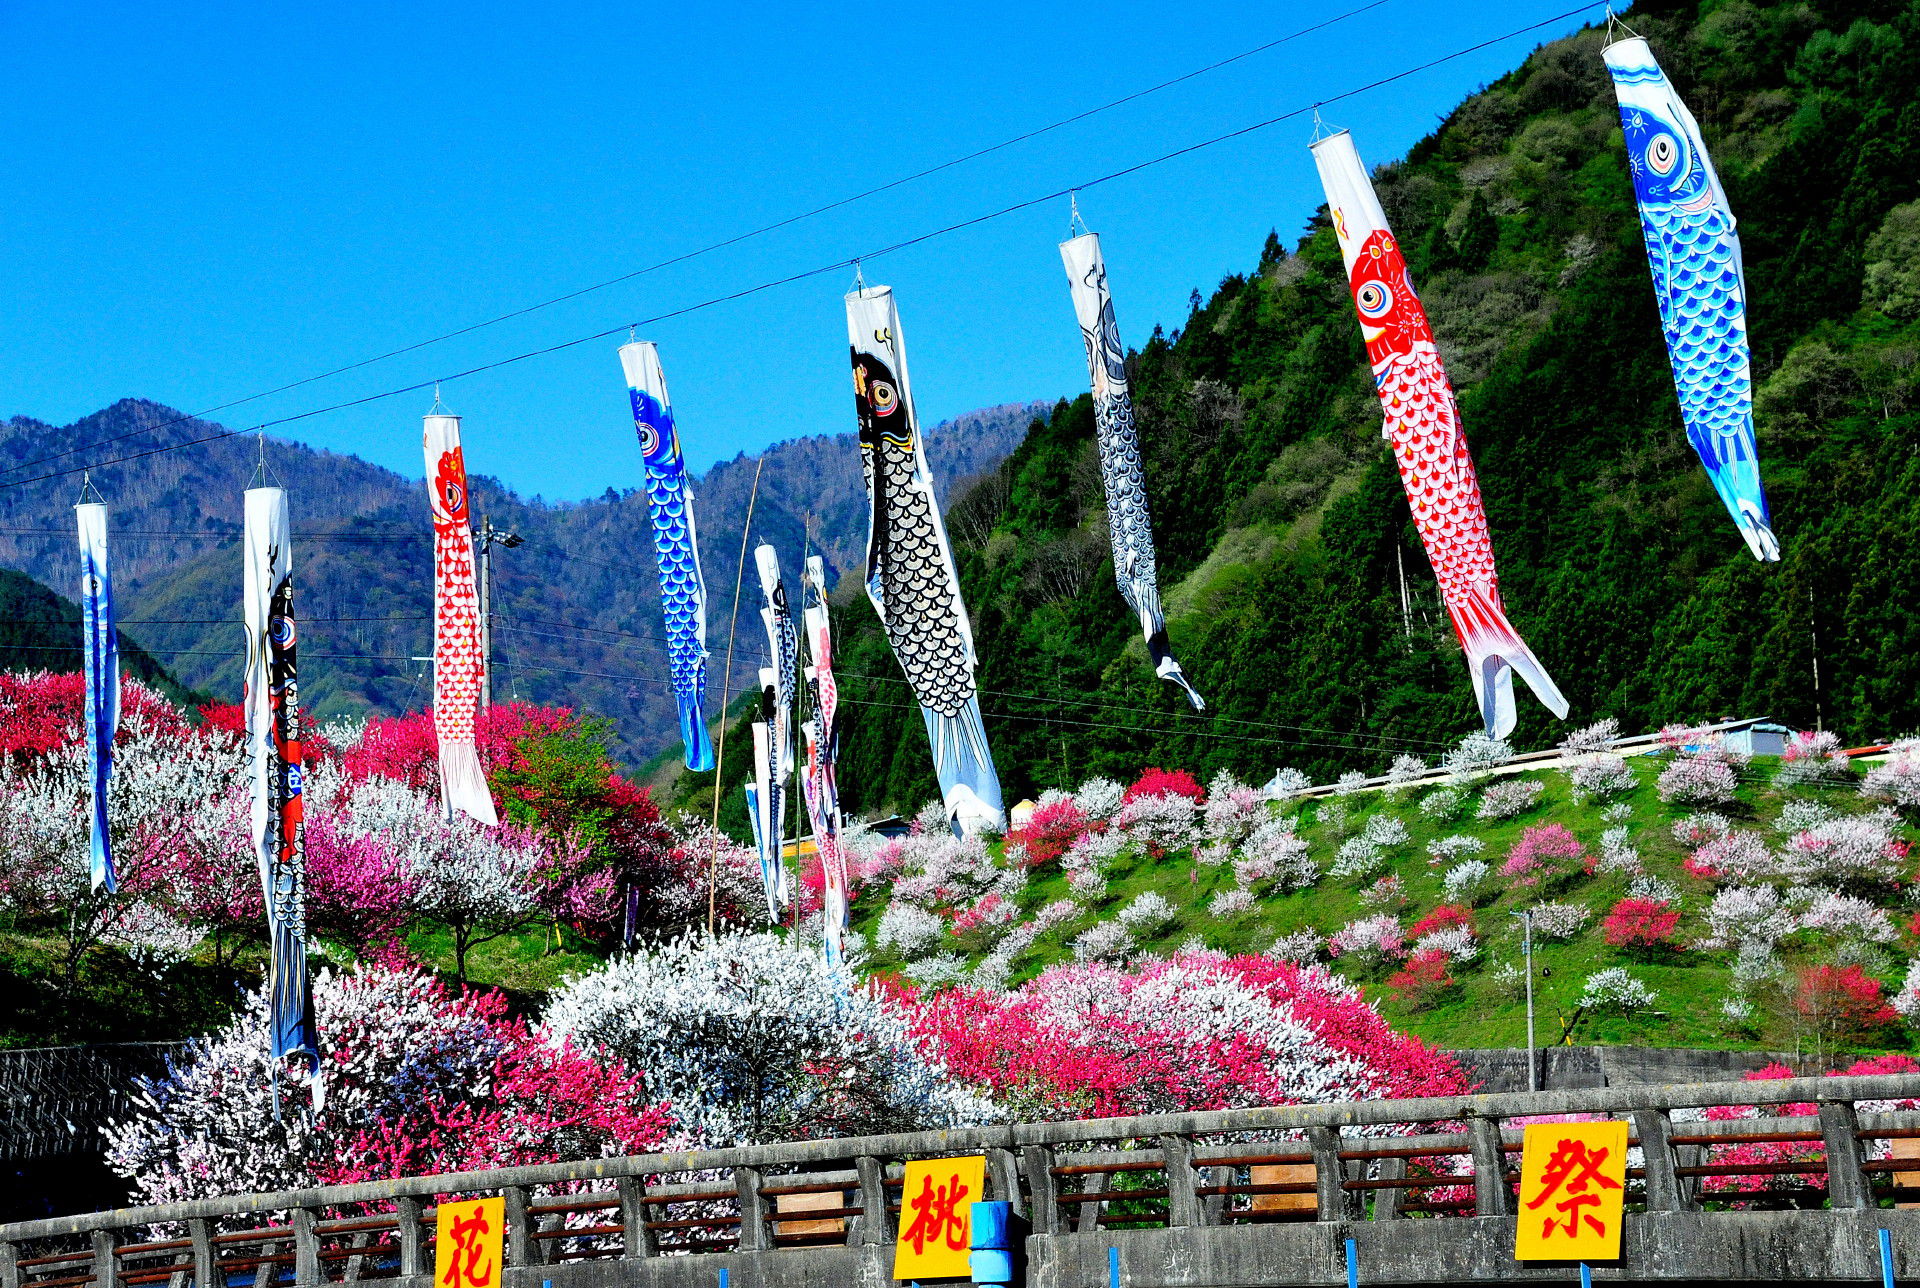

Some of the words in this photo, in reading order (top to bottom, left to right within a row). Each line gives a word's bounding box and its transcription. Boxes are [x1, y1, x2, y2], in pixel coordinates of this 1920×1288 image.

[900, 1174, 968, 1256] 桃
[1525, 1138, 1623, 1240] 祭
[443, 1206, 492, 1288] 花
